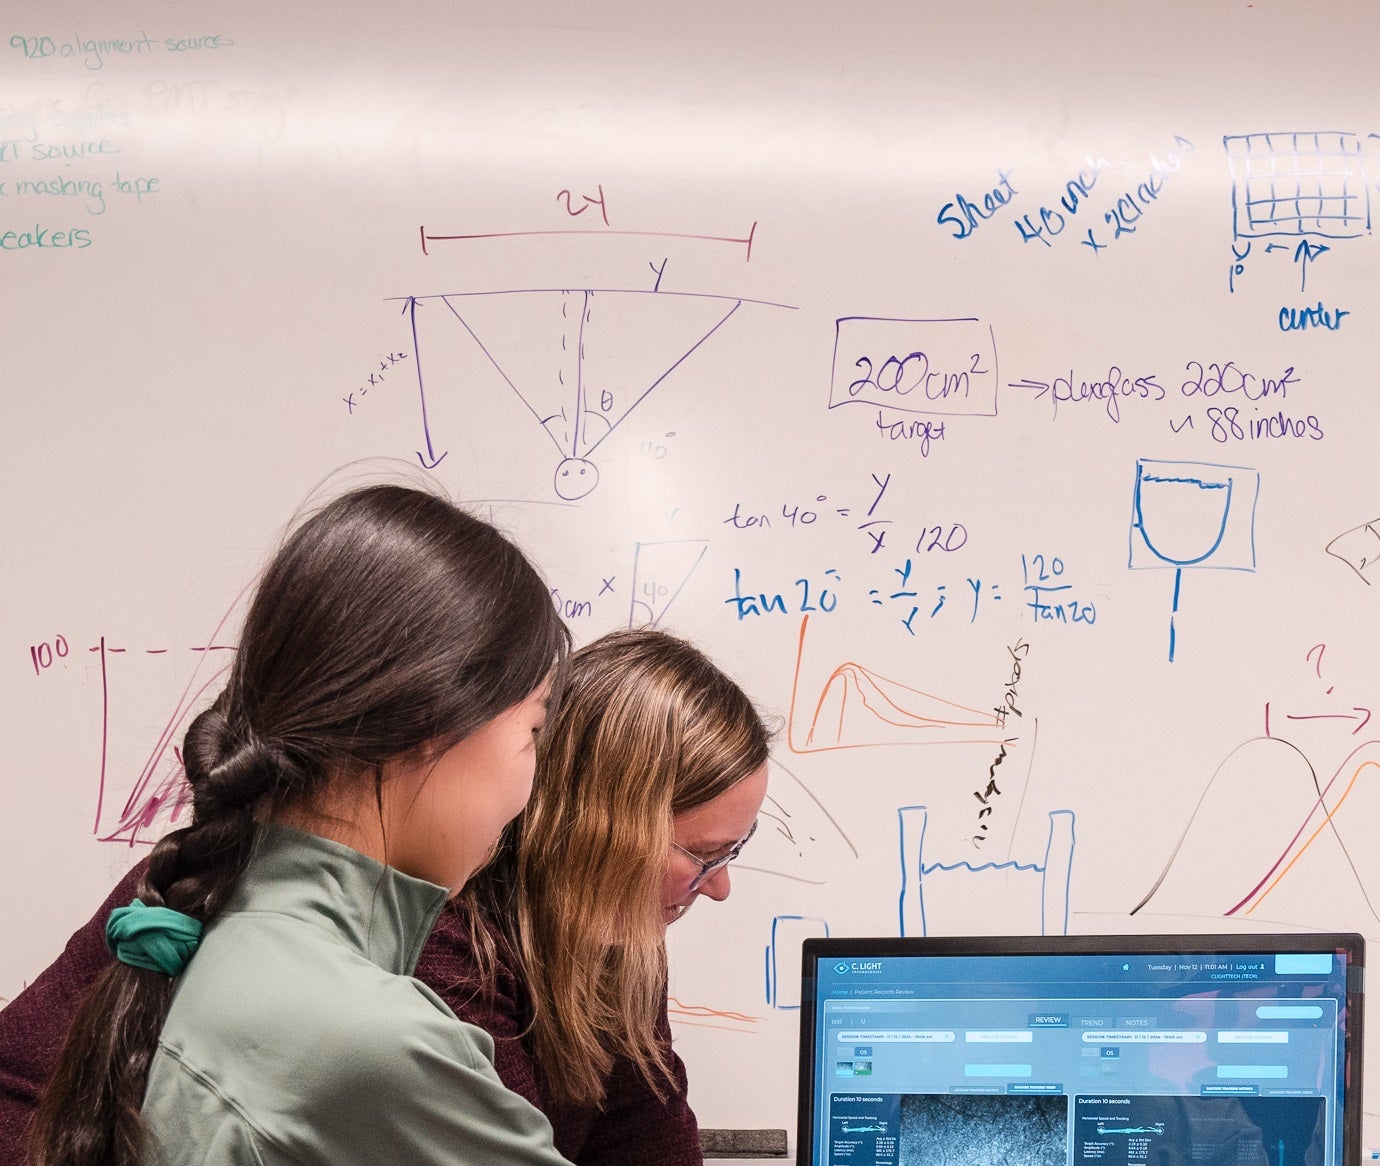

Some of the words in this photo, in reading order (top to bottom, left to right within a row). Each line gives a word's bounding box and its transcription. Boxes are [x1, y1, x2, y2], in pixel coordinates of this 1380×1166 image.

[10, 35, 56, 59] 920
[60, 30, 160, 70] alignment
[0, 224, 92, 250] eakers
